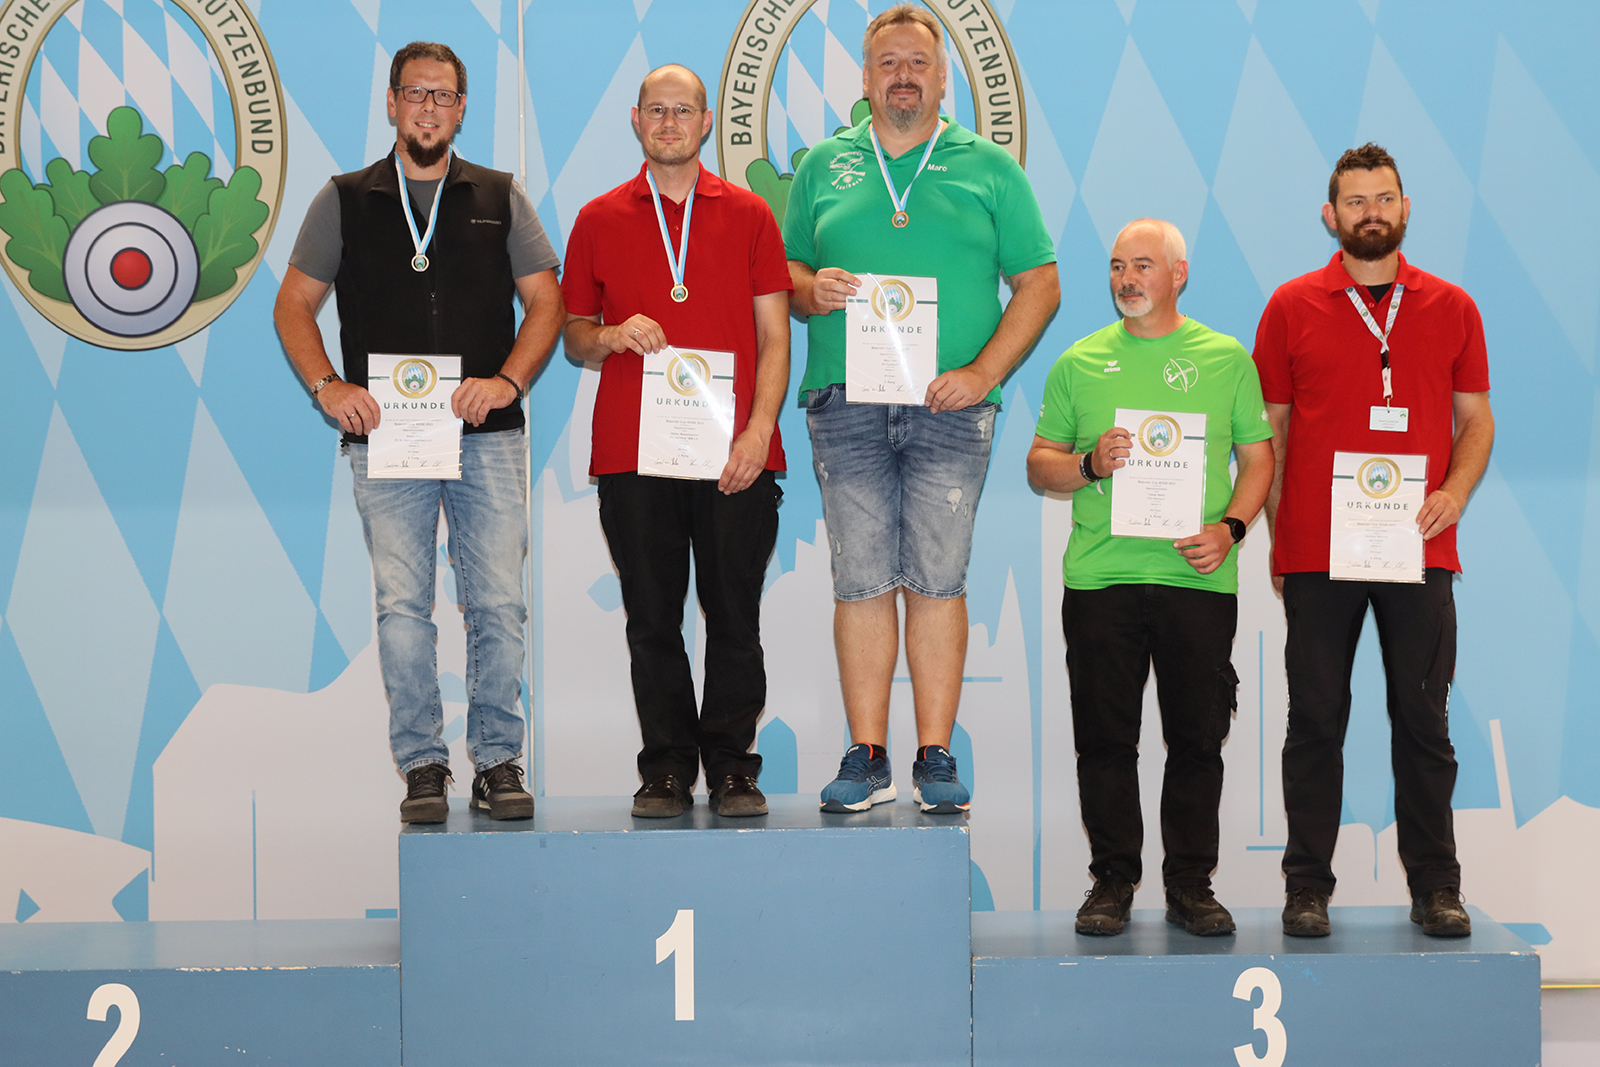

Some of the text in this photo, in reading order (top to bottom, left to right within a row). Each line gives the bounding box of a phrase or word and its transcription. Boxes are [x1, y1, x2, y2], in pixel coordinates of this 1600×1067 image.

[195, 0, 274, 155] ÜTZENBUND
[926, 163, 948, 172] Marc
[861, 325, 923, 334] URKNDE
[383, 402, 446, 410] URKUNDE
[656, 397, 711, 408] URKUND
[1128, 459, 1189, 469] URKUNDE
[1347, 501, 1409, 511] URKUNDE
[655, 909, 695, 1021] 1
[1232, 967, 1287, 1067] 3
[86, 982, 141, 1067] 2
